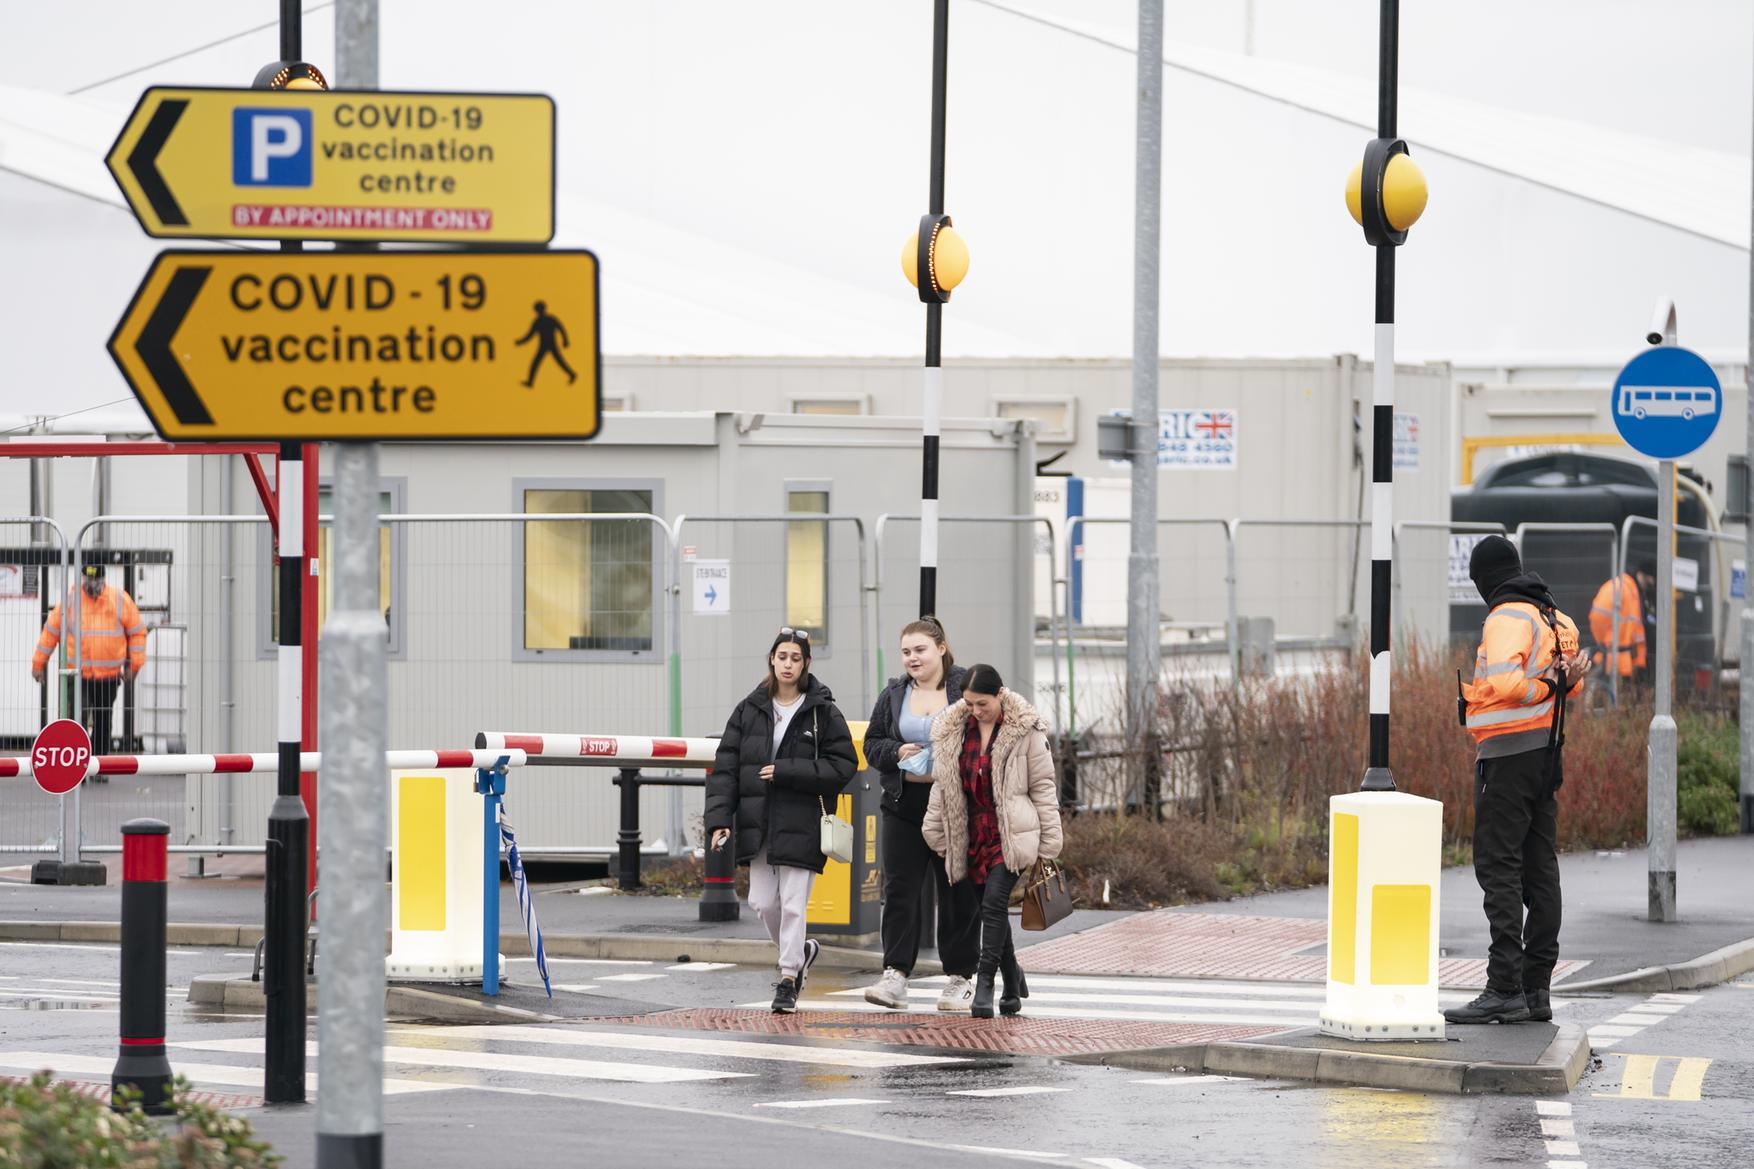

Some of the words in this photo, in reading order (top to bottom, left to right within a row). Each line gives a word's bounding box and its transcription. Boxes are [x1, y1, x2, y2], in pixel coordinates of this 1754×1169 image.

[333, 103, 483, 131] COVID-19
[251, 115, 303, 181] P
[321, 137, 494, 162] vaccination
[359, 170, 456, 194] centre
[235, 206, 263, 226] BY
[269, 208, 428, 228] APPOINTMENT
[431, 210, 491, 230] ONLY
[220, 324, 496, 363] vaccination
[282, 376, 437, 414] centre
[35, 746, 89, 767] STOP
[590, 741, 610, 753] STOP
